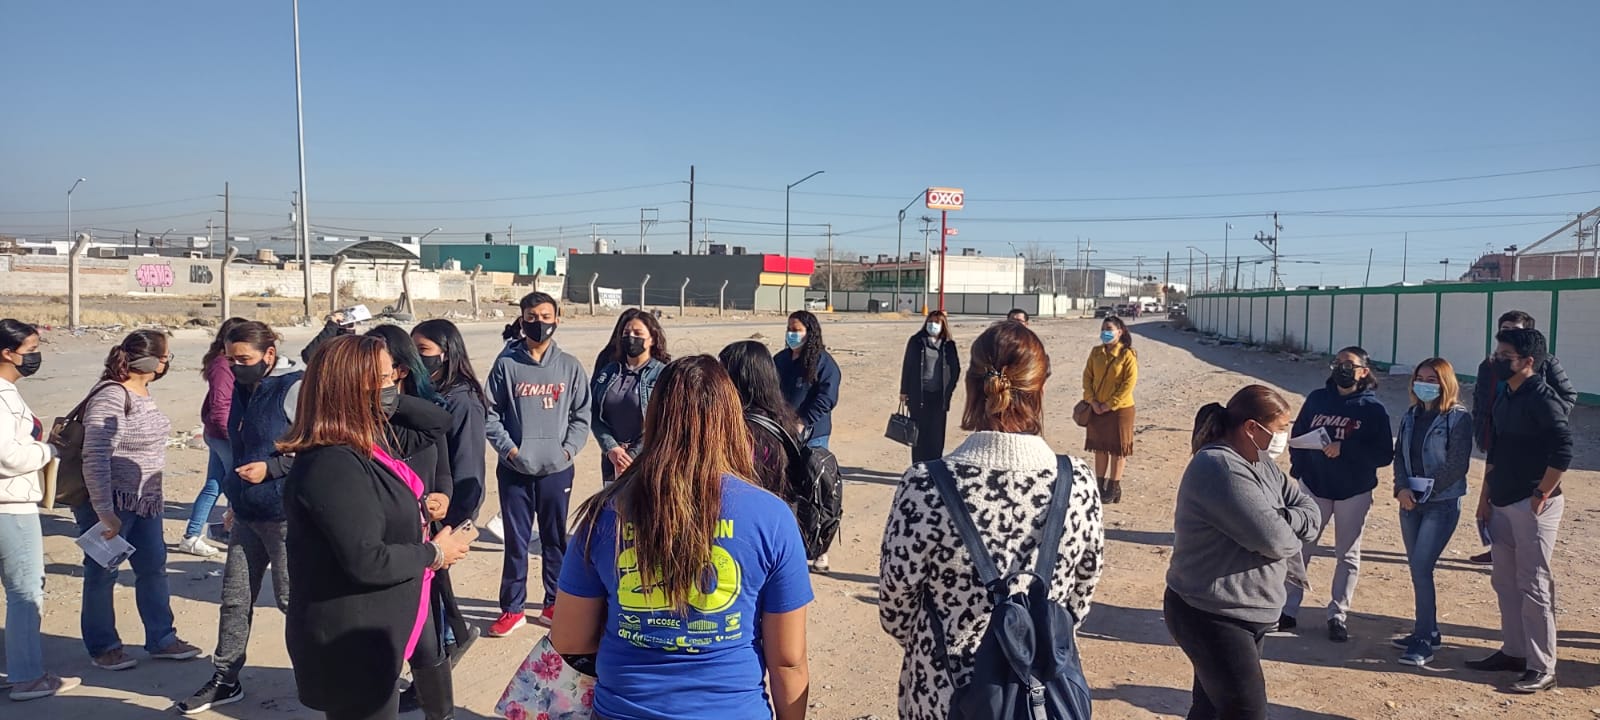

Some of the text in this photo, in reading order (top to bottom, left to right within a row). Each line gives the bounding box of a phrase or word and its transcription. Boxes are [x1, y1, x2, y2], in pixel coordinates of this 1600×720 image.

[929, 192, 963, 205] OXXO
[543, 397, 554, 409] 11
[1335, 428, 1345, 440] 11
